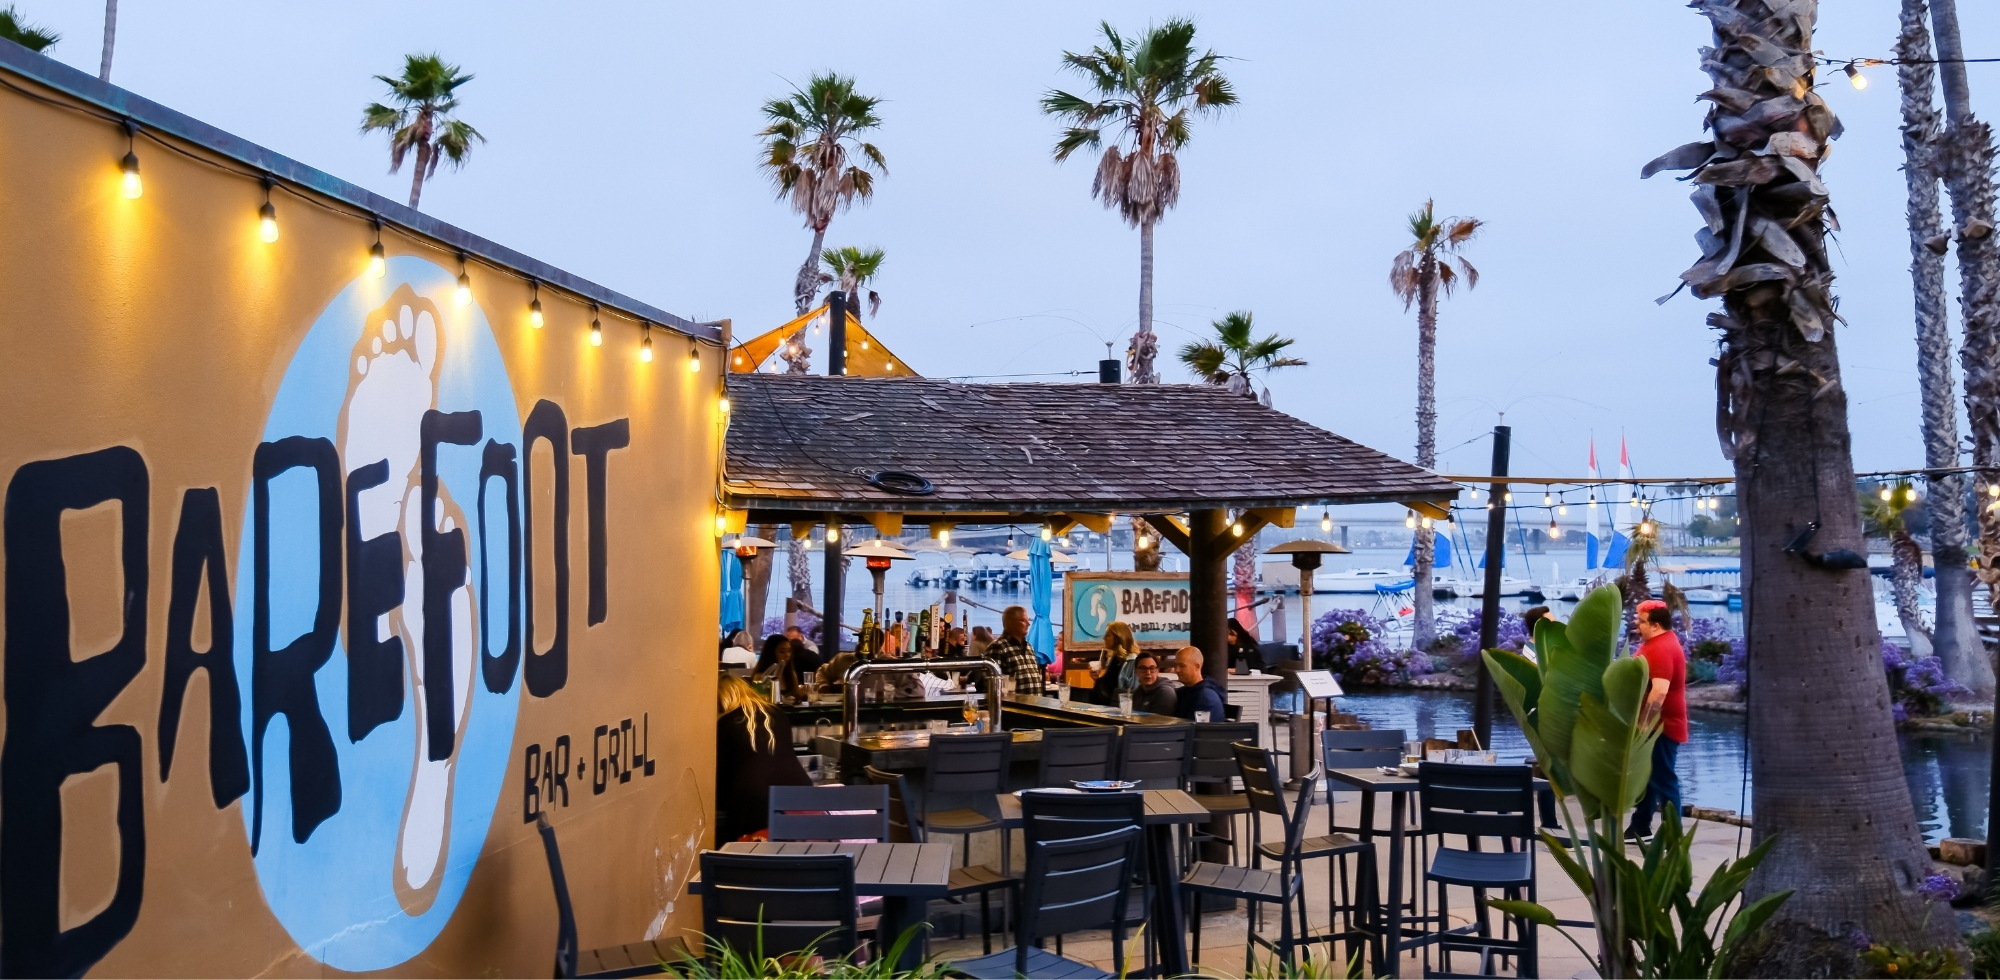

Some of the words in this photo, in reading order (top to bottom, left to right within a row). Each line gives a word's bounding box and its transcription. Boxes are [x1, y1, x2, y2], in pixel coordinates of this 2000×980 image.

[1121, 588, 1190, 614] BAREFOO
[4, 399, 630, 980] BAREFOOT
[524, 735, 570, 824] BAR
[593, 712, 655, 796] GRILL
